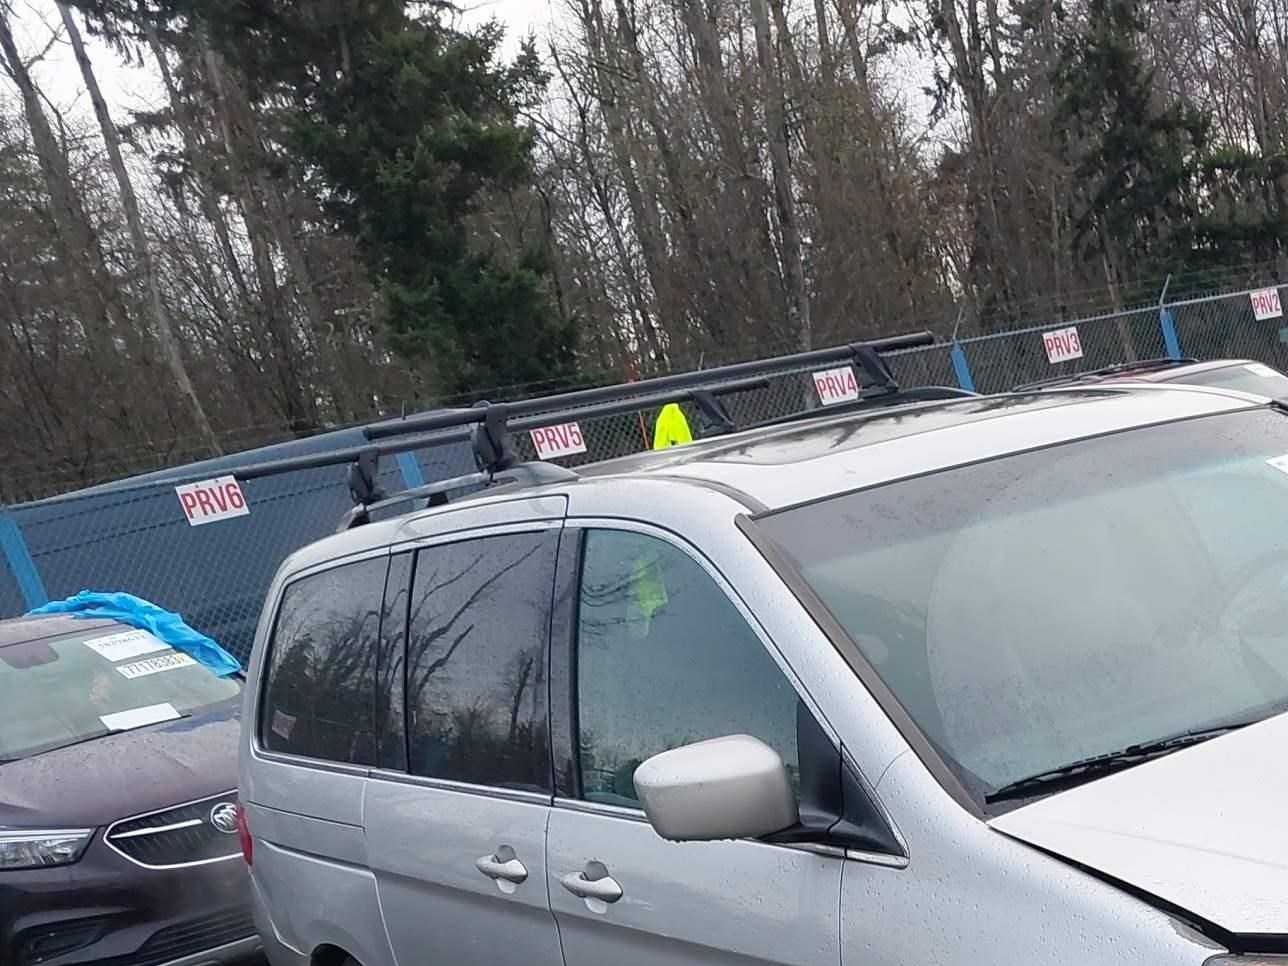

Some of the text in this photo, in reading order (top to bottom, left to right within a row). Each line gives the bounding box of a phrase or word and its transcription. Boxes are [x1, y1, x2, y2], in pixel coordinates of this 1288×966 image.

[1252, 294, 1280, 315] PRV2
[1046, 333, 1080, 358] PRV3
[816, 373, 856, 399] PRV4
[533, 424, 582, 453] PRV5
[181, 483, 244, 519] PRV6
